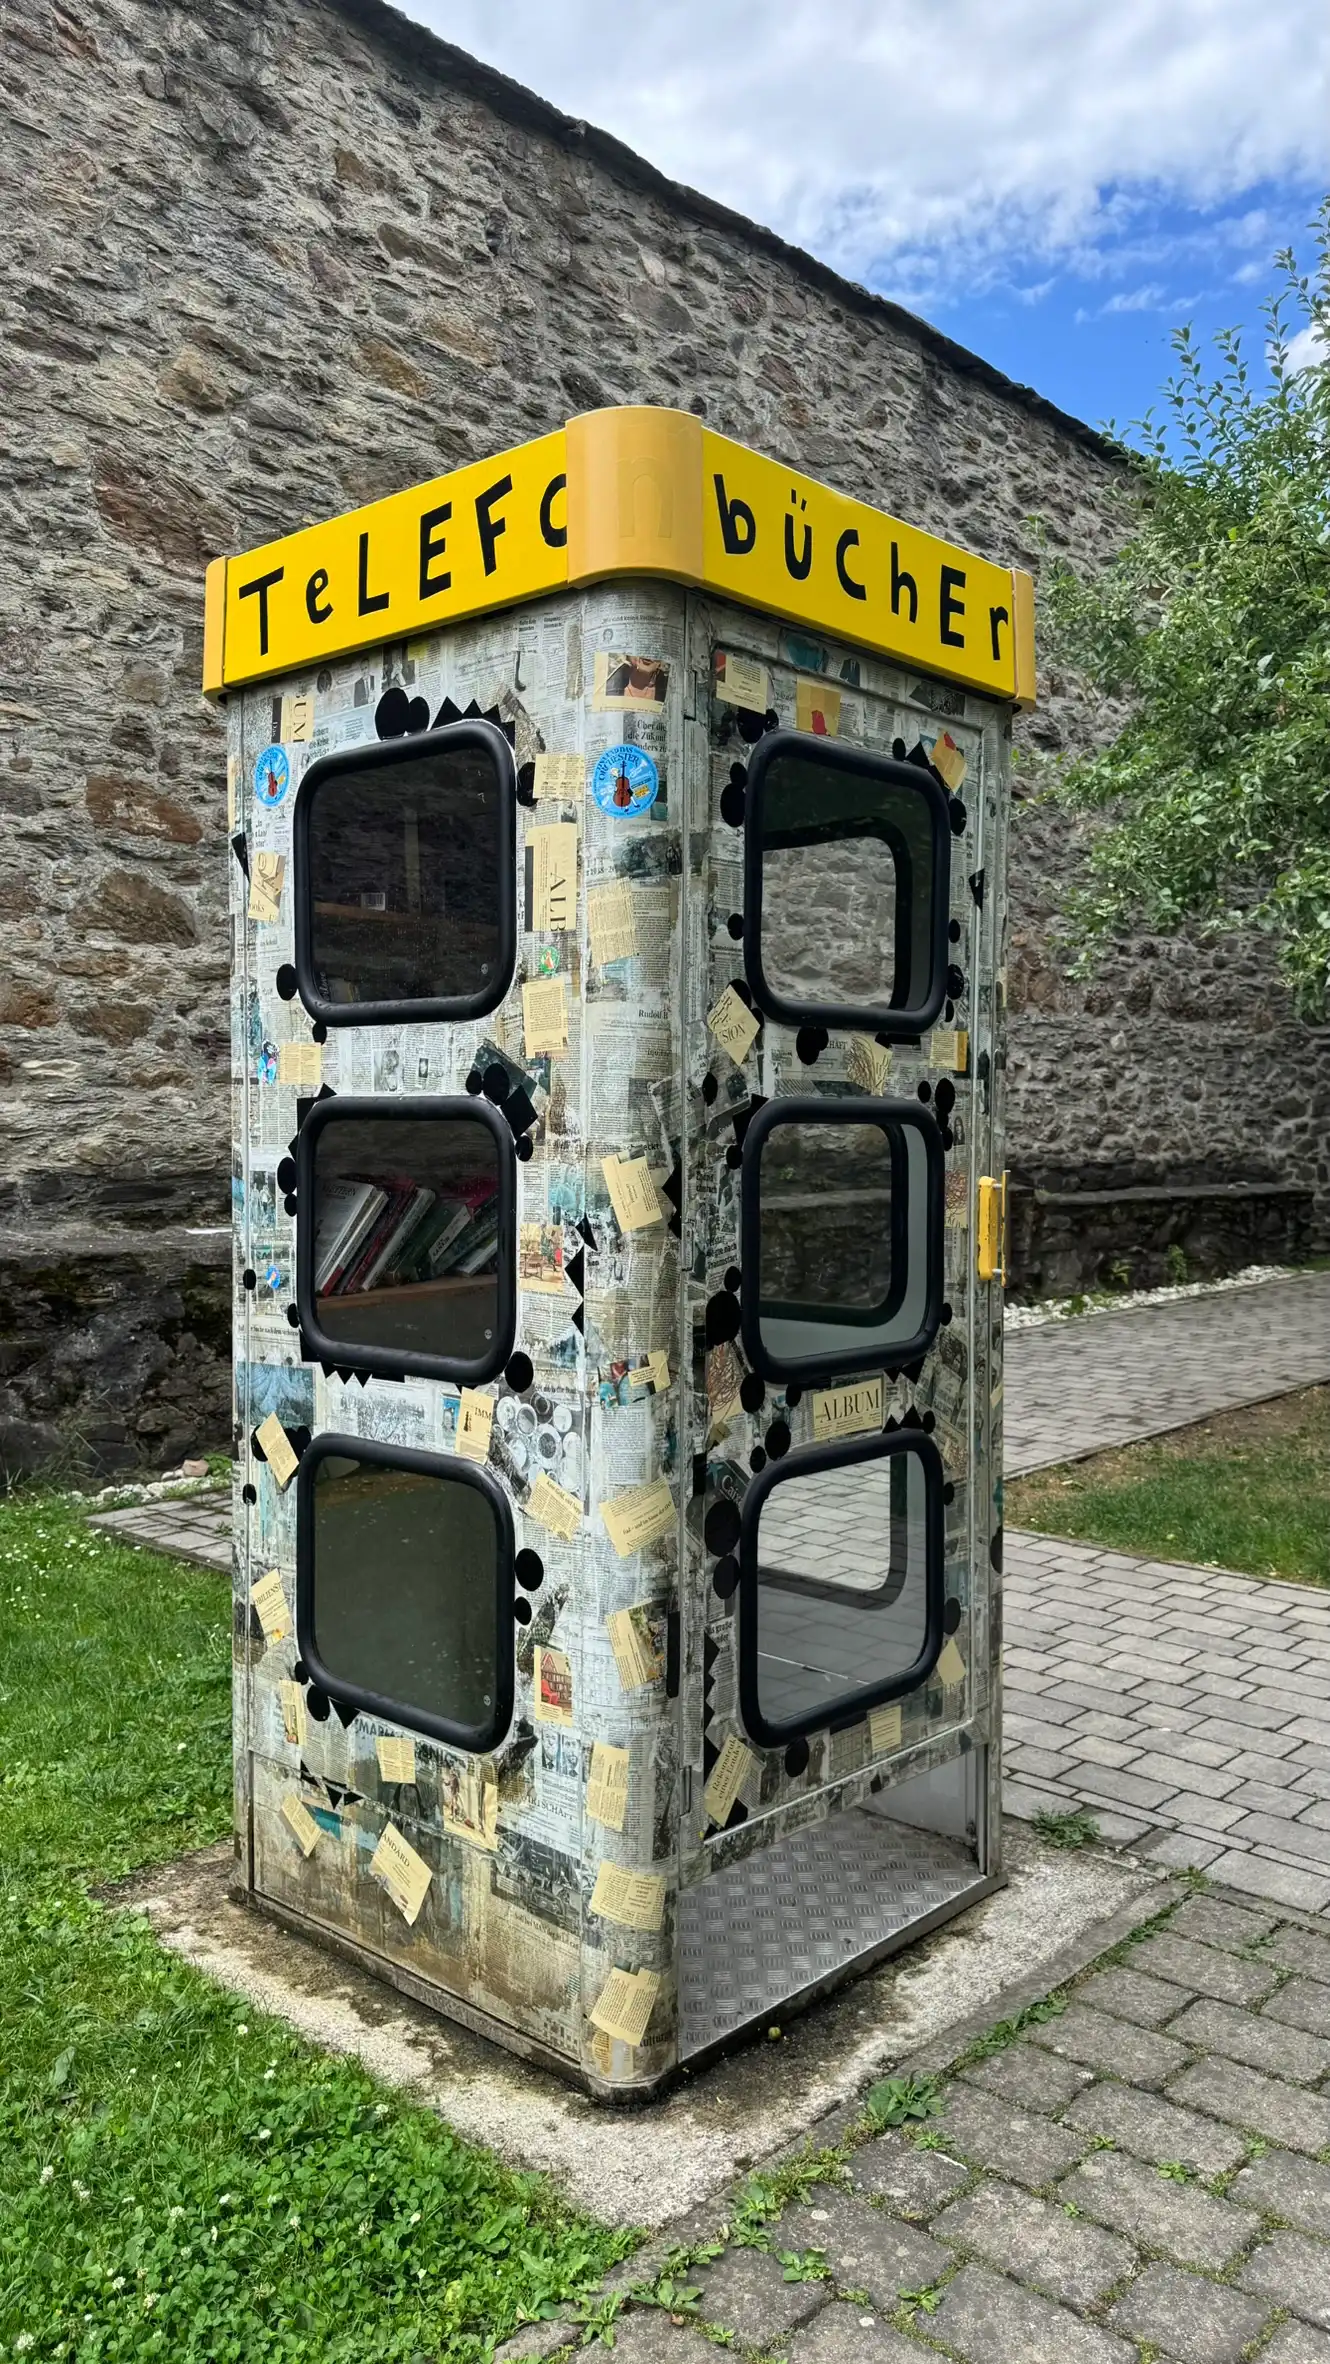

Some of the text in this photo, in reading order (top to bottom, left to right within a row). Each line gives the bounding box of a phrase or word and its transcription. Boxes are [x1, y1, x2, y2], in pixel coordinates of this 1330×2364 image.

[550, 873, 567, 932] ALB
[820, 1387, 881, 1424] ALBUM
[382, 1832, 410, 1868] ANDARD
